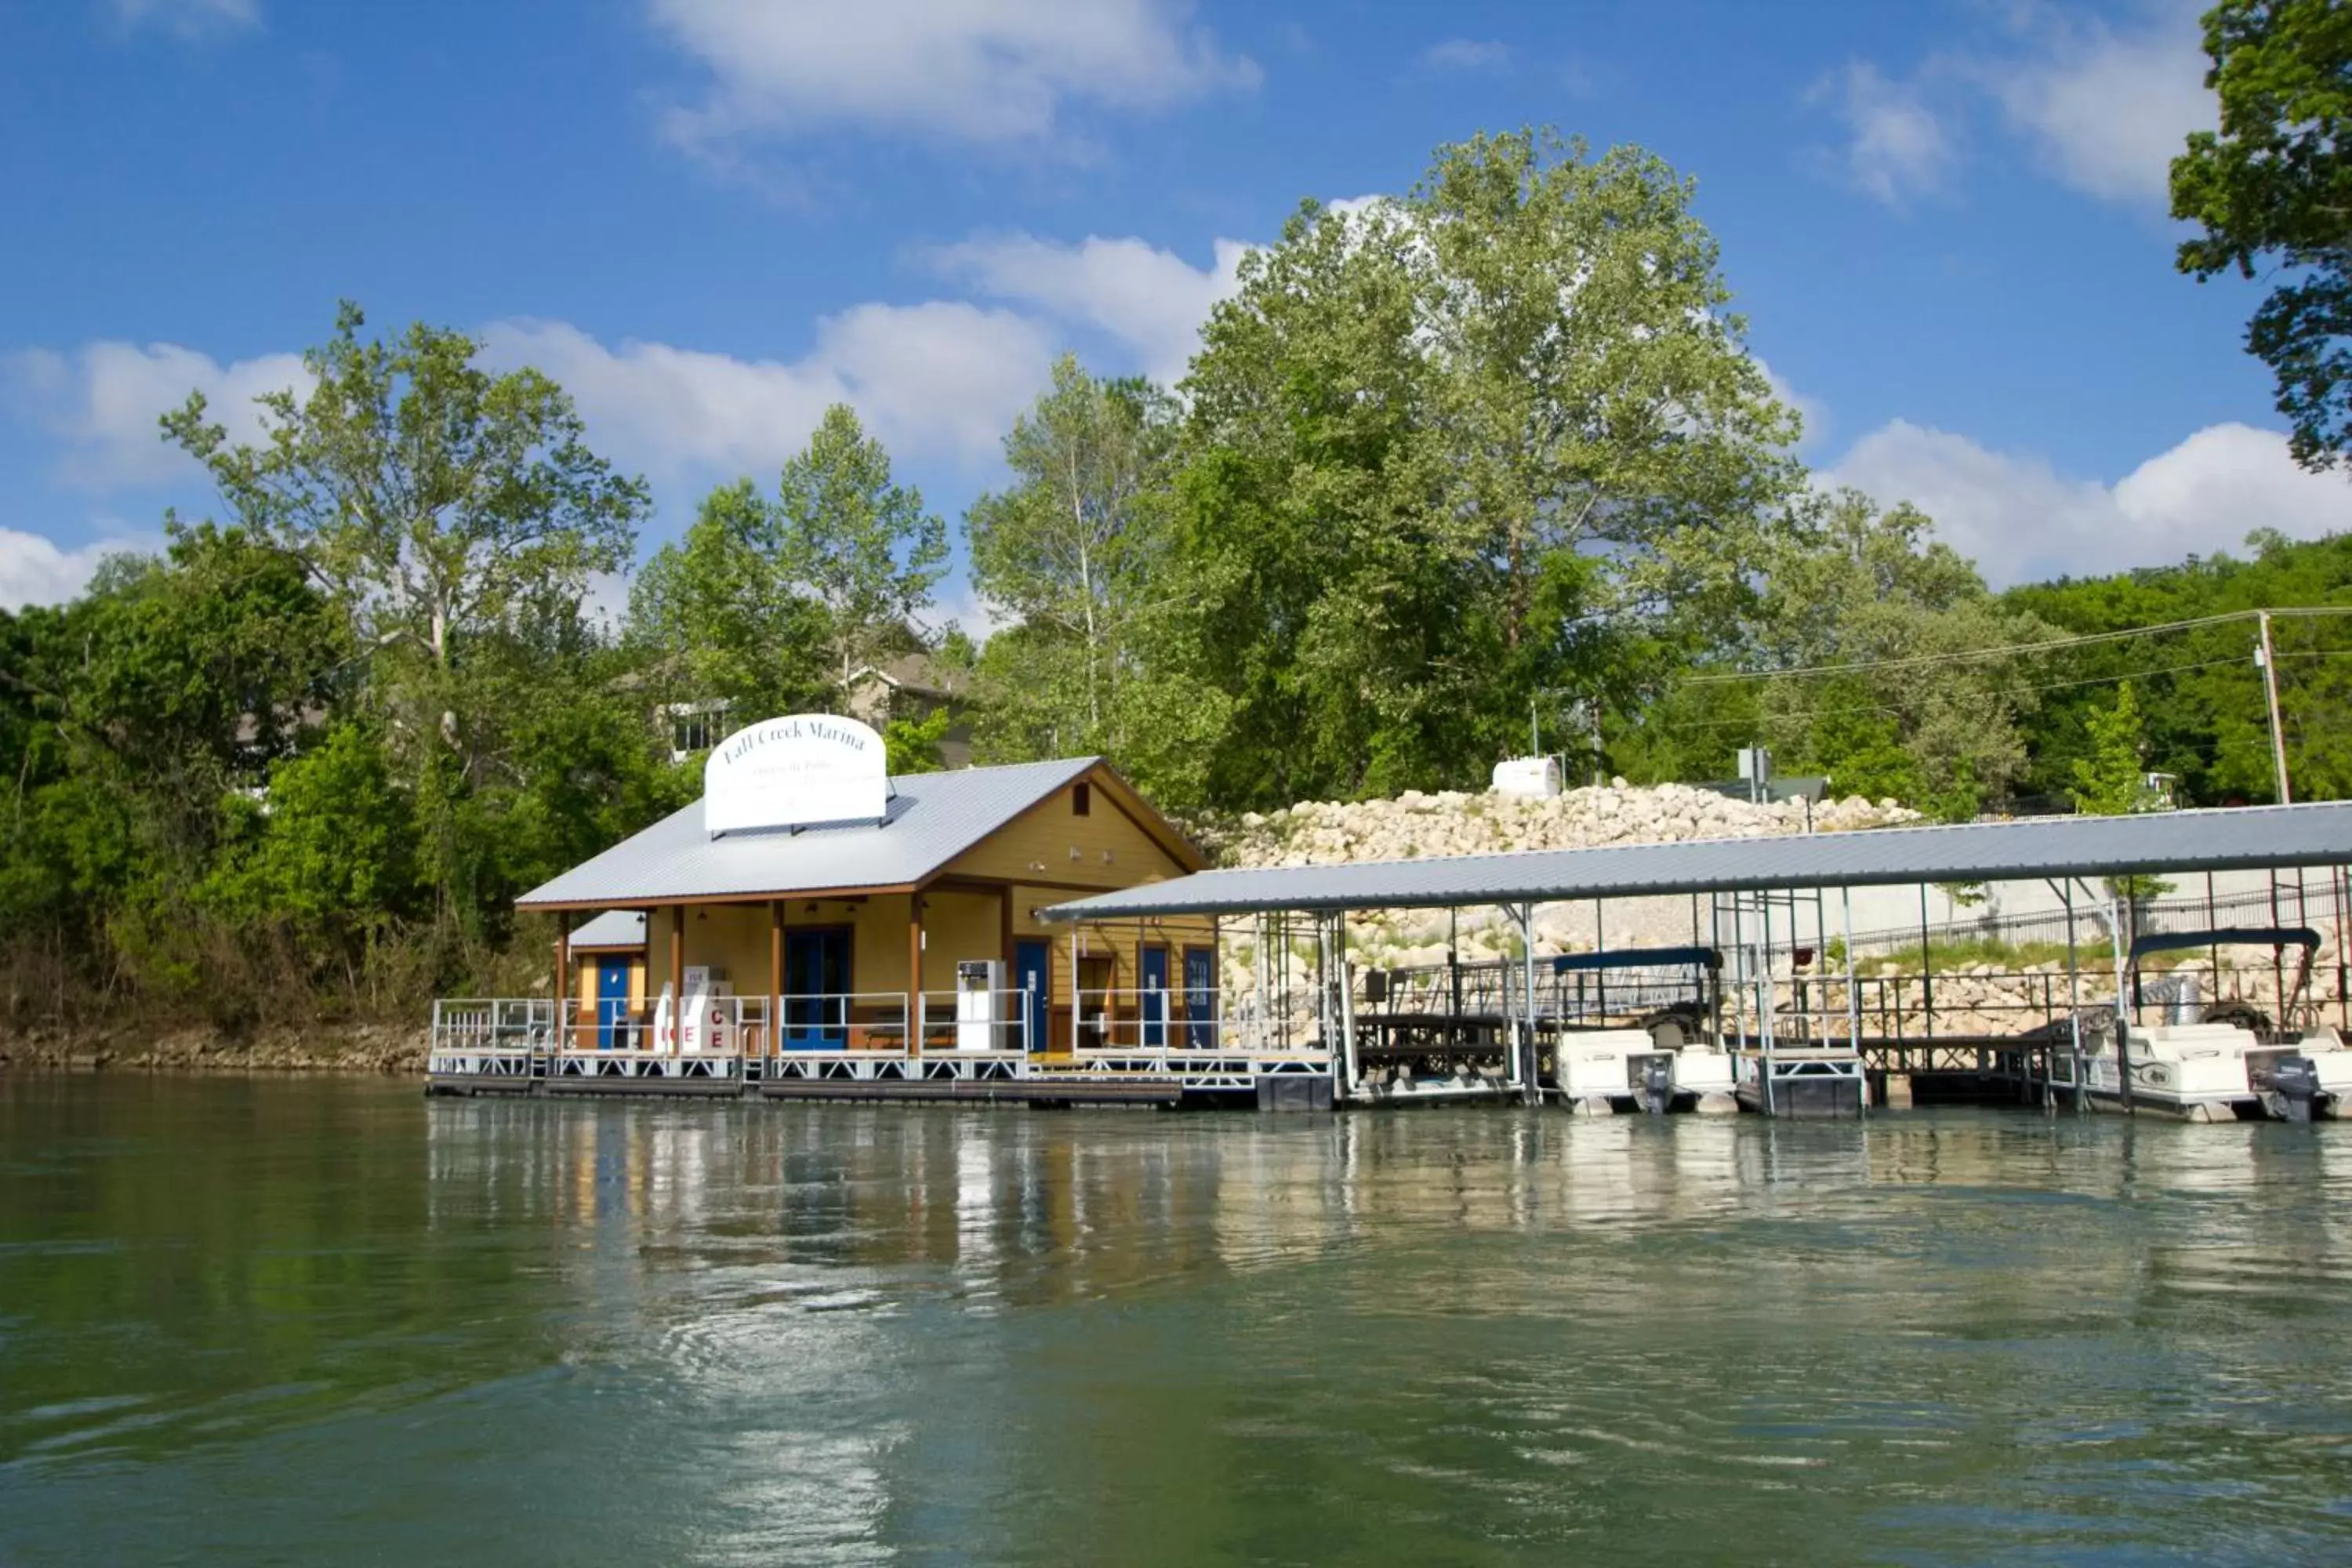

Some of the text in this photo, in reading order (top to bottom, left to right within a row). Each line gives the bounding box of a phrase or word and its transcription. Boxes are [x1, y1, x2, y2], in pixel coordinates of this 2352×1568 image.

[758, 720, 803, 745] Creek
[809, 721, 866, 751] Marina
[711, 986, 723, 1047] ICE
[661, 1026, 694, 1042] IE
